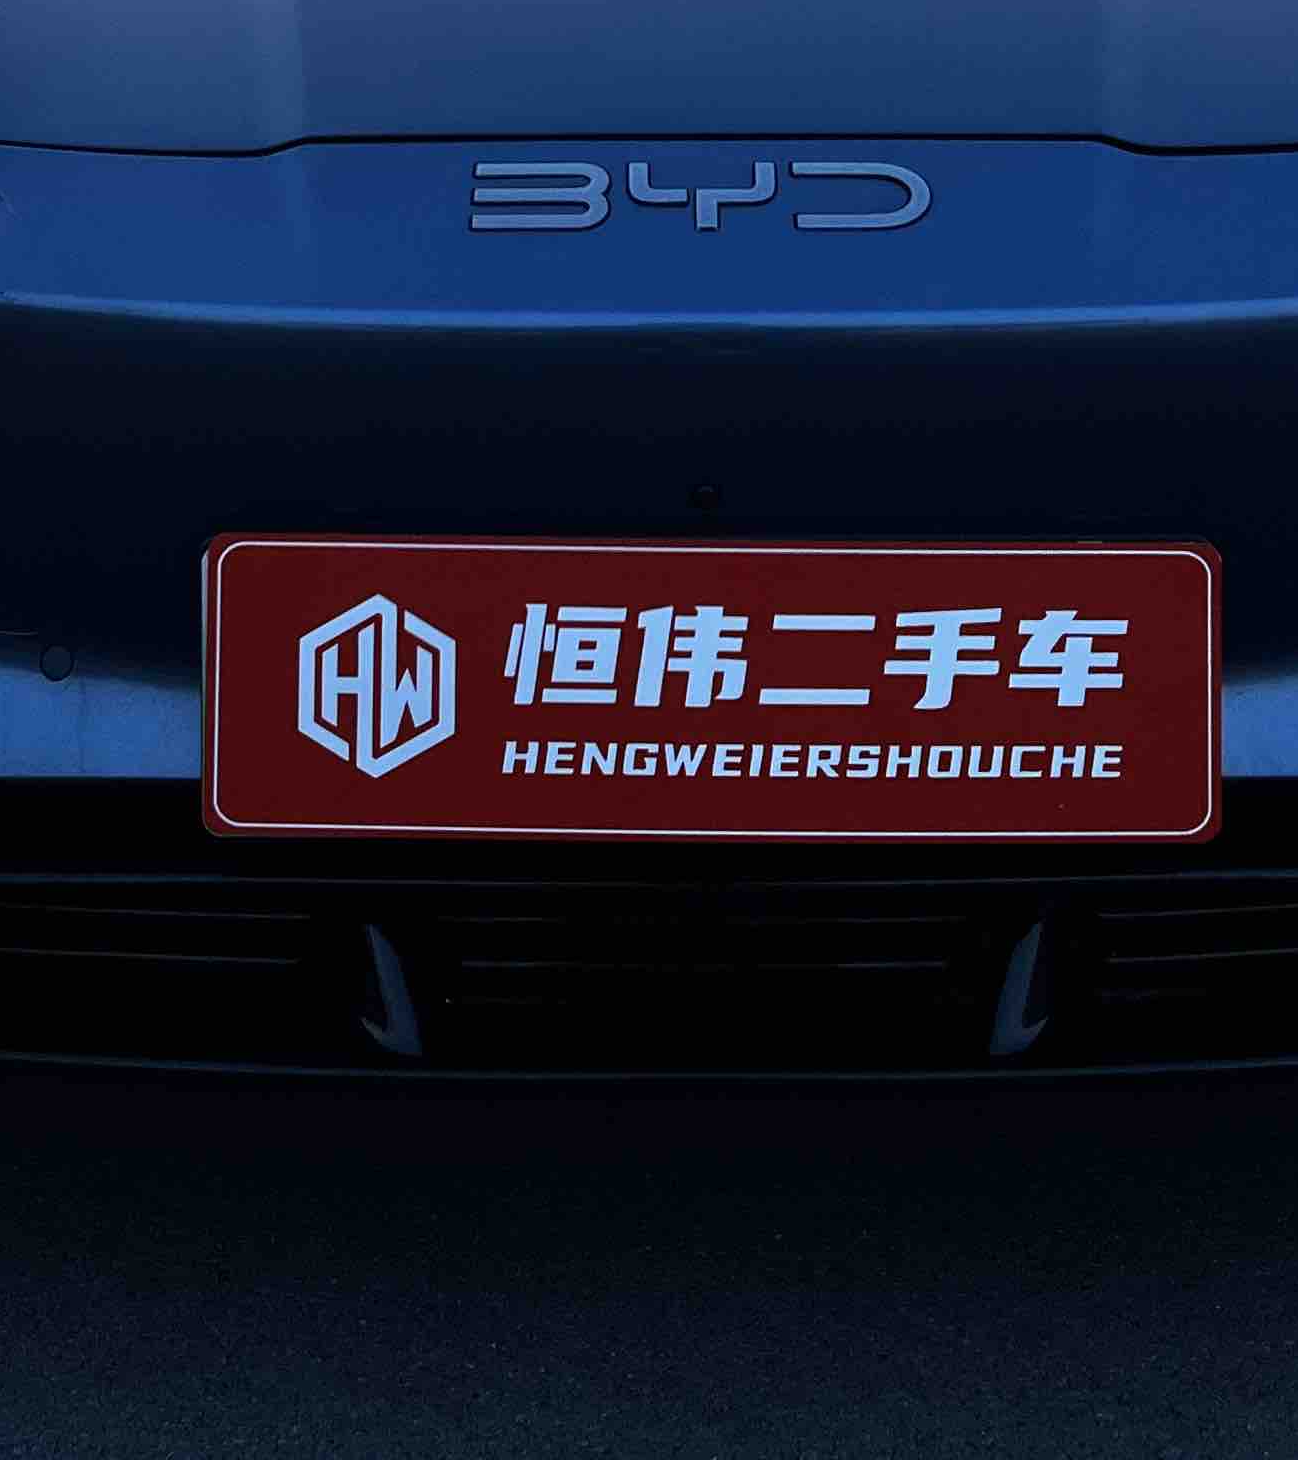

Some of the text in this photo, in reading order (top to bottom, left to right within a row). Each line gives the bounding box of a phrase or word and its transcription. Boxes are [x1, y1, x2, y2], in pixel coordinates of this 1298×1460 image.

[471, 162, 931, 229] BYD
[505, 603, 1129, 709] 恒伟二手车
[503, 741, 1123, 779] HENGWEIERSHOUCHE
